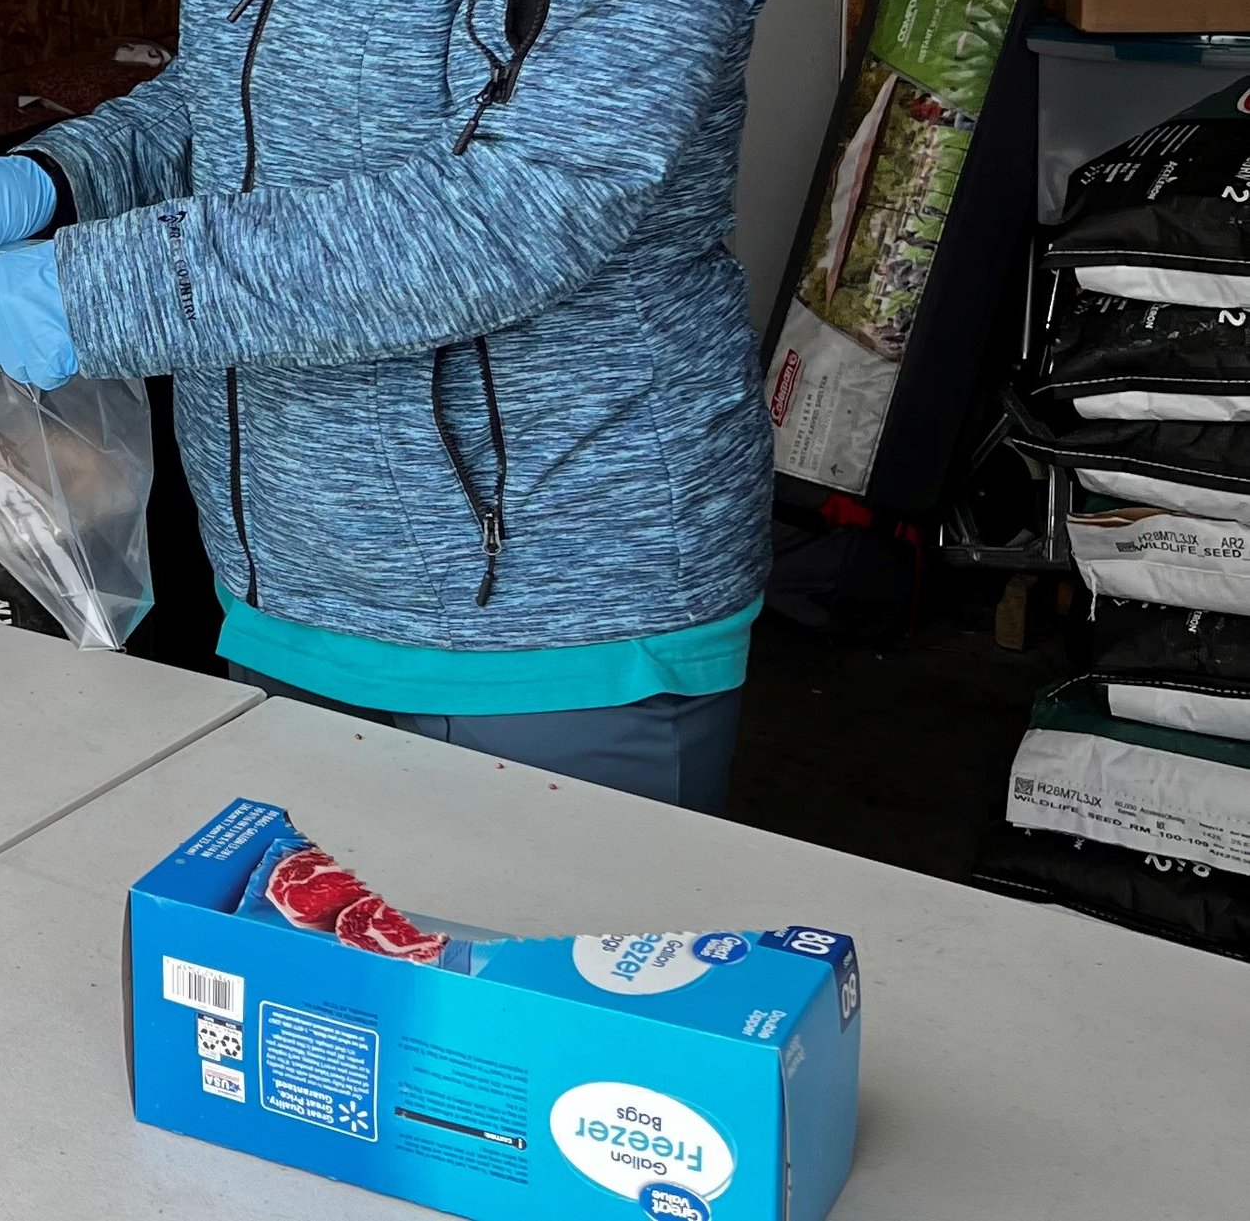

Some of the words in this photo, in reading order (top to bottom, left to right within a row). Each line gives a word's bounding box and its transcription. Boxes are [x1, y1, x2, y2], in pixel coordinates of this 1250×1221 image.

[772, 365, 794, 419] Coleman
[1221, 537, 1245, 550] AR2
[651, 940, 684, 968] Gallon
[791, 930, 837, 955] 80
[610, 933, 664, 982] eezer
[841, 972, 857, 1020] 80
[757, 1009, 788, 1040] Double
[205, 1073, 231, 1091] USA
[306, 1098, 334, 1114] Great
[306, 1108, 334, 1124] Great
[617, 1106, 662, 1132] Bags
[575, 1117, 703, 1173] Freezer
[611, 1150, 668, 1176] Gallon
[651, 1198, 704, 1221] Great
[652, 1189, 691, 1210] Value
